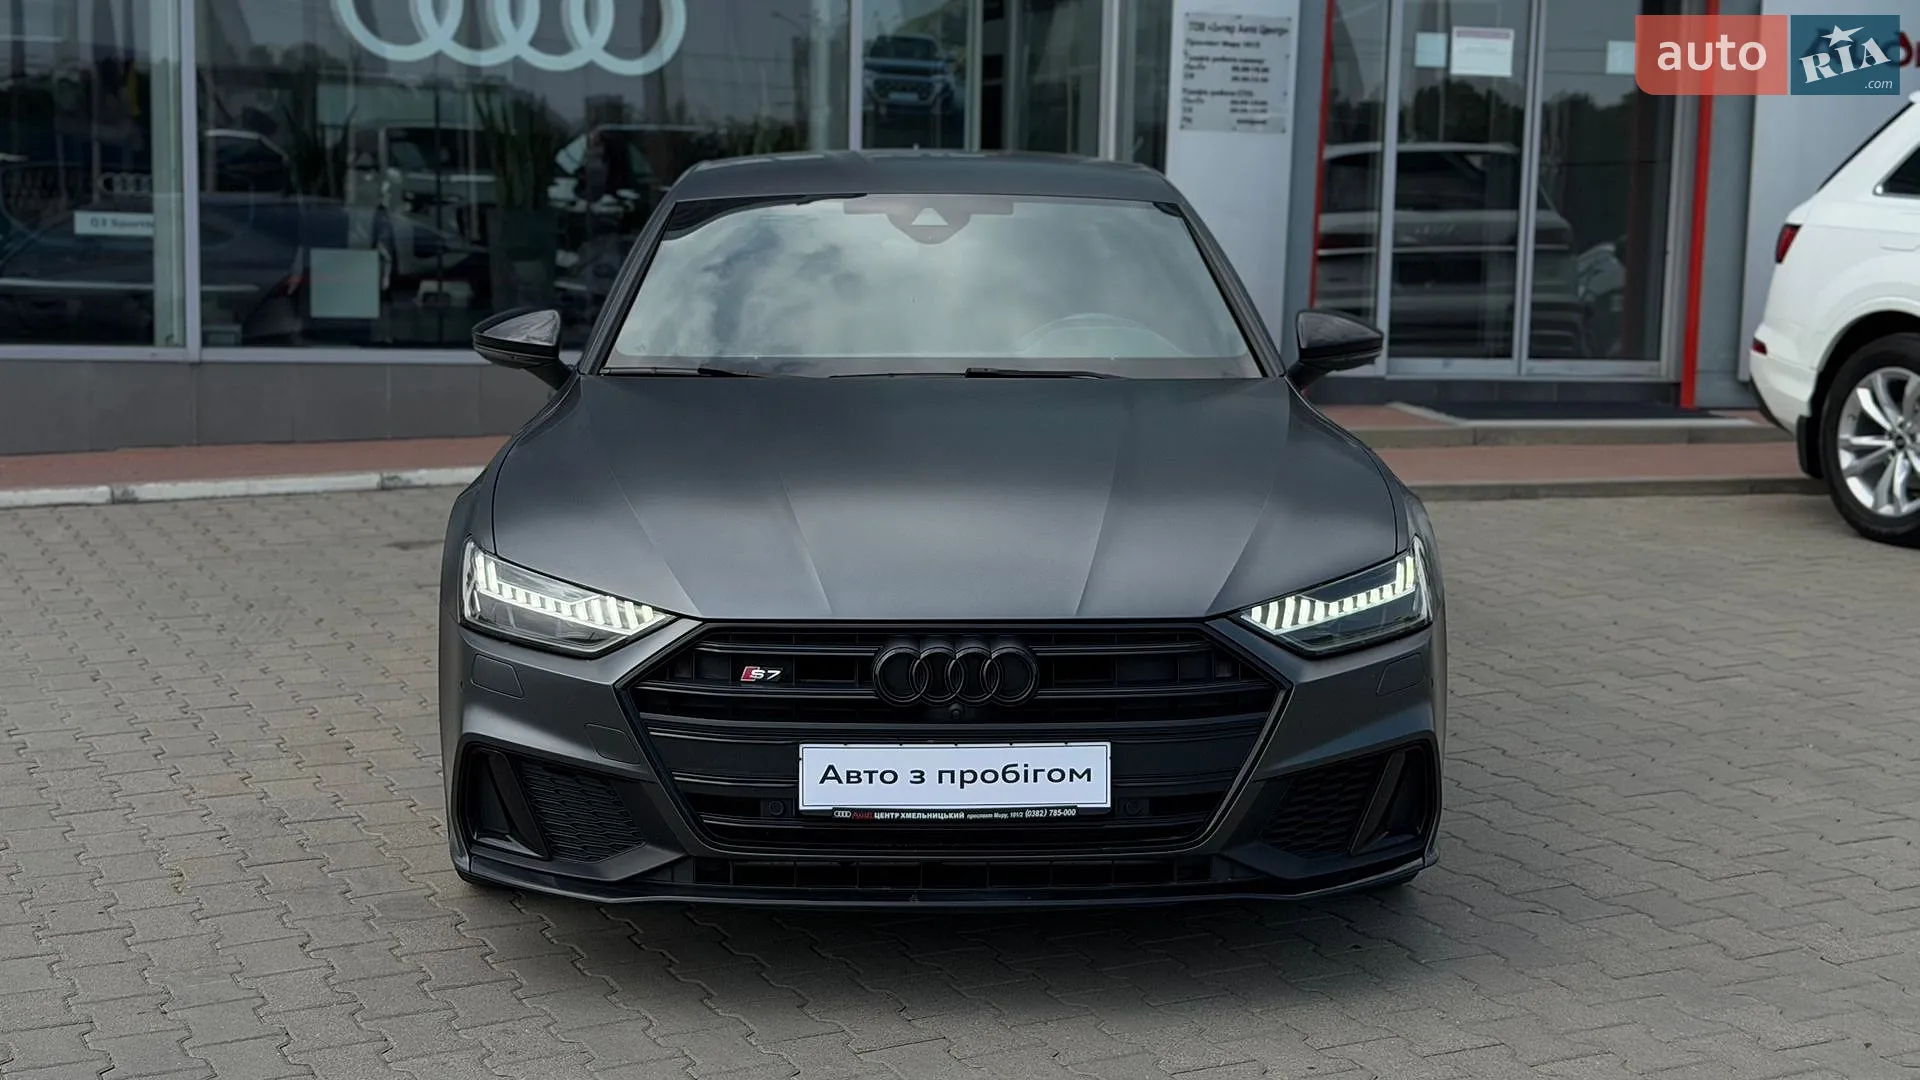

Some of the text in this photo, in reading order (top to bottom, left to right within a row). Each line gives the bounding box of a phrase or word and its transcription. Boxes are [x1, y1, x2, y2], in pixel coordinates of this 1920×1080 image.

[748, 668, 782, 681] S7
[818, 762, 1092, 789] Авто з пробігом
[874, 811, 899, 820] ЦЕНТР
[900, 811, 965, 820] ХМЕЛЬНИЦЬКИЙ
[1025, 808, 1048, 819] (0382)
[1048, 808, 1077, 818] 785-000
